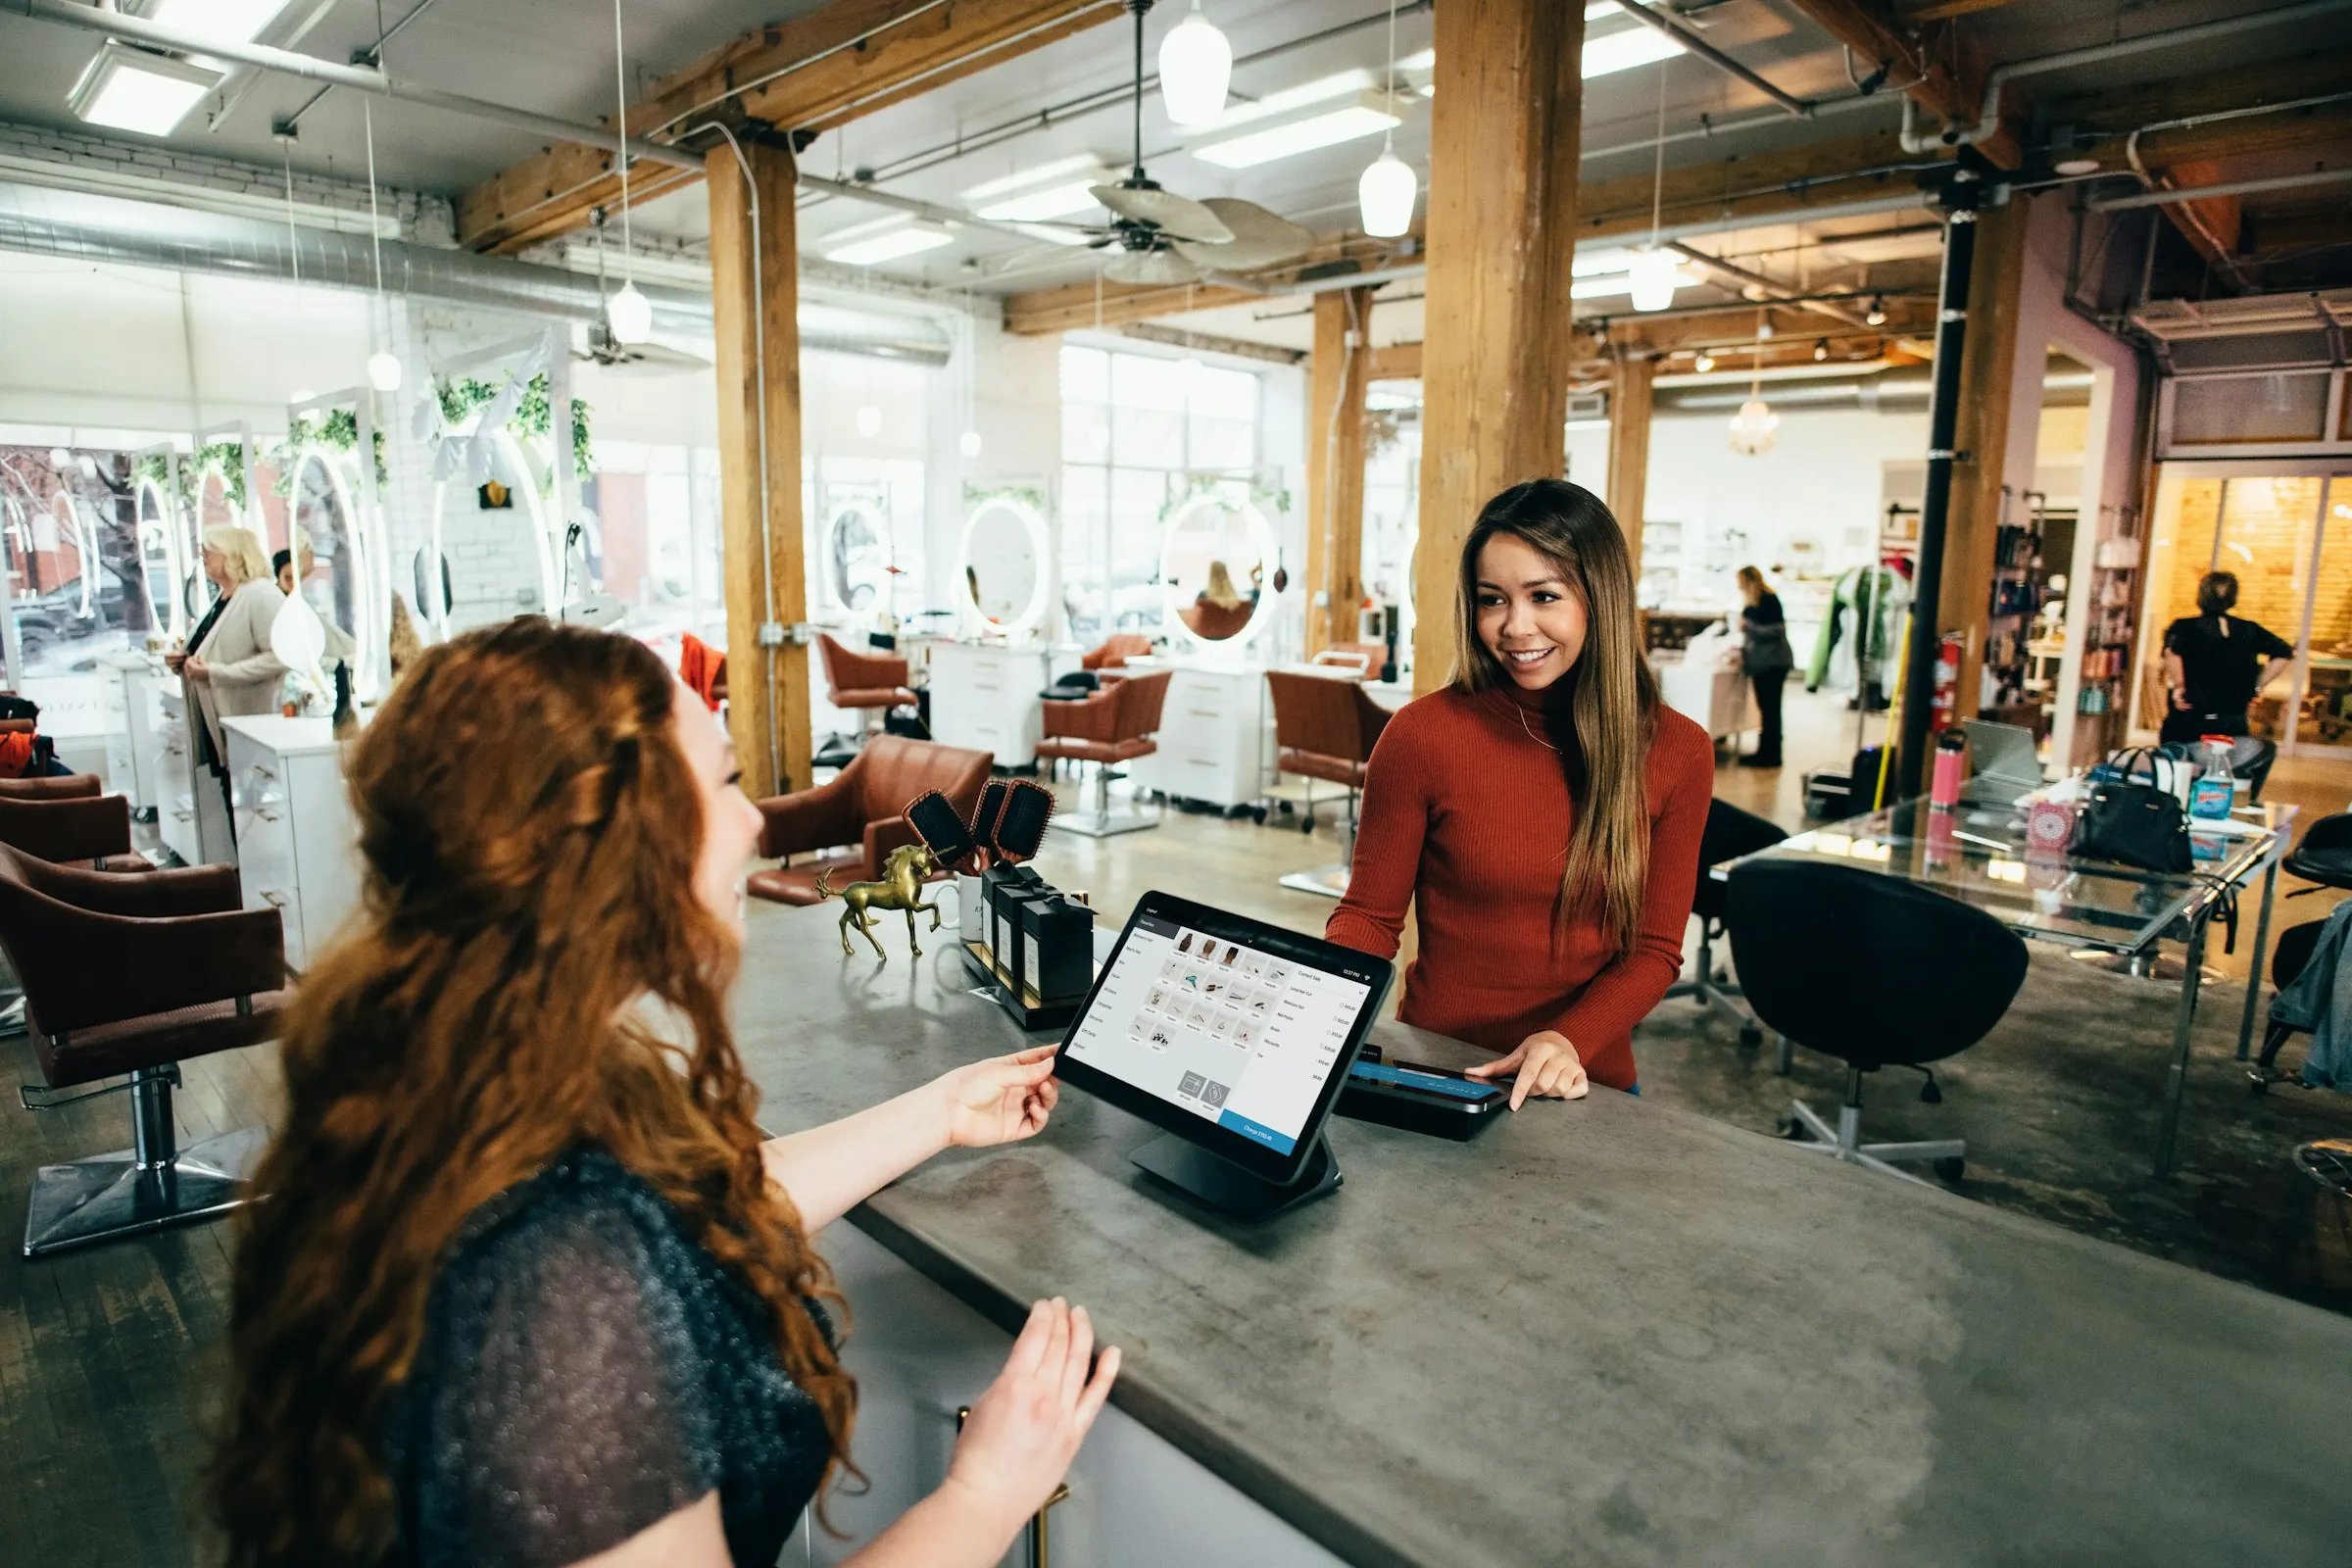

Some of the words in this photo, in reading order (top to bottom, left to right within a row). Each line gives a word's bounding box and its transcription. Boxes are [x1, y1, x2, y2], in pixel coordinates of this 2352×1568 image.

[1097, 1001, 1112, 1010] Categories
[1088, 1014, 1103, 1023] Discounts
[1264, 1039, 1279, 1047] Discounts
[1244, 1125, 1258, 1135] Charge
